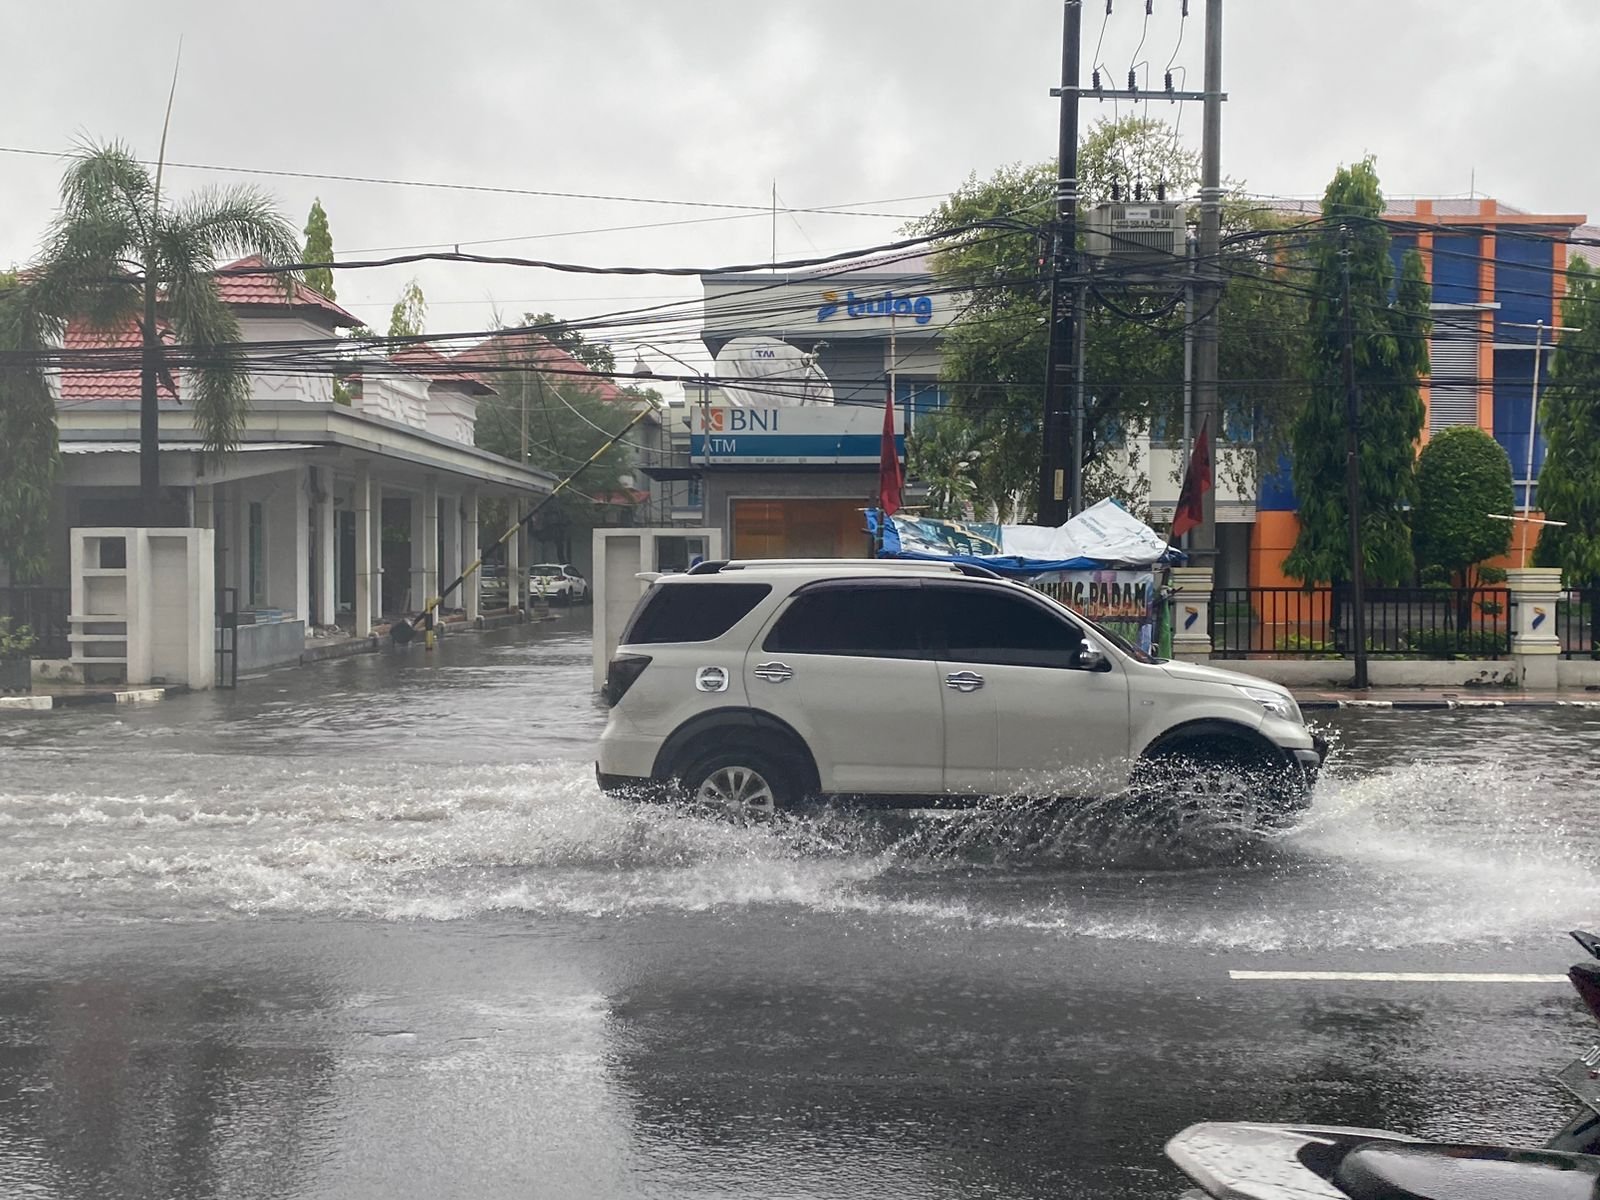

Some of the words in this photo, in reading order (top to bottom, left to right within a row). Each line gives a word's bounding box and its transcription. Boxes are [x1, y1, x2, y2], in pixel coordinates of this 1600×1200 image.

[847, 291, 932, 324] bulog
[730, 409, 778, 431] BNI
[701, 439, 736, 453] ATM
